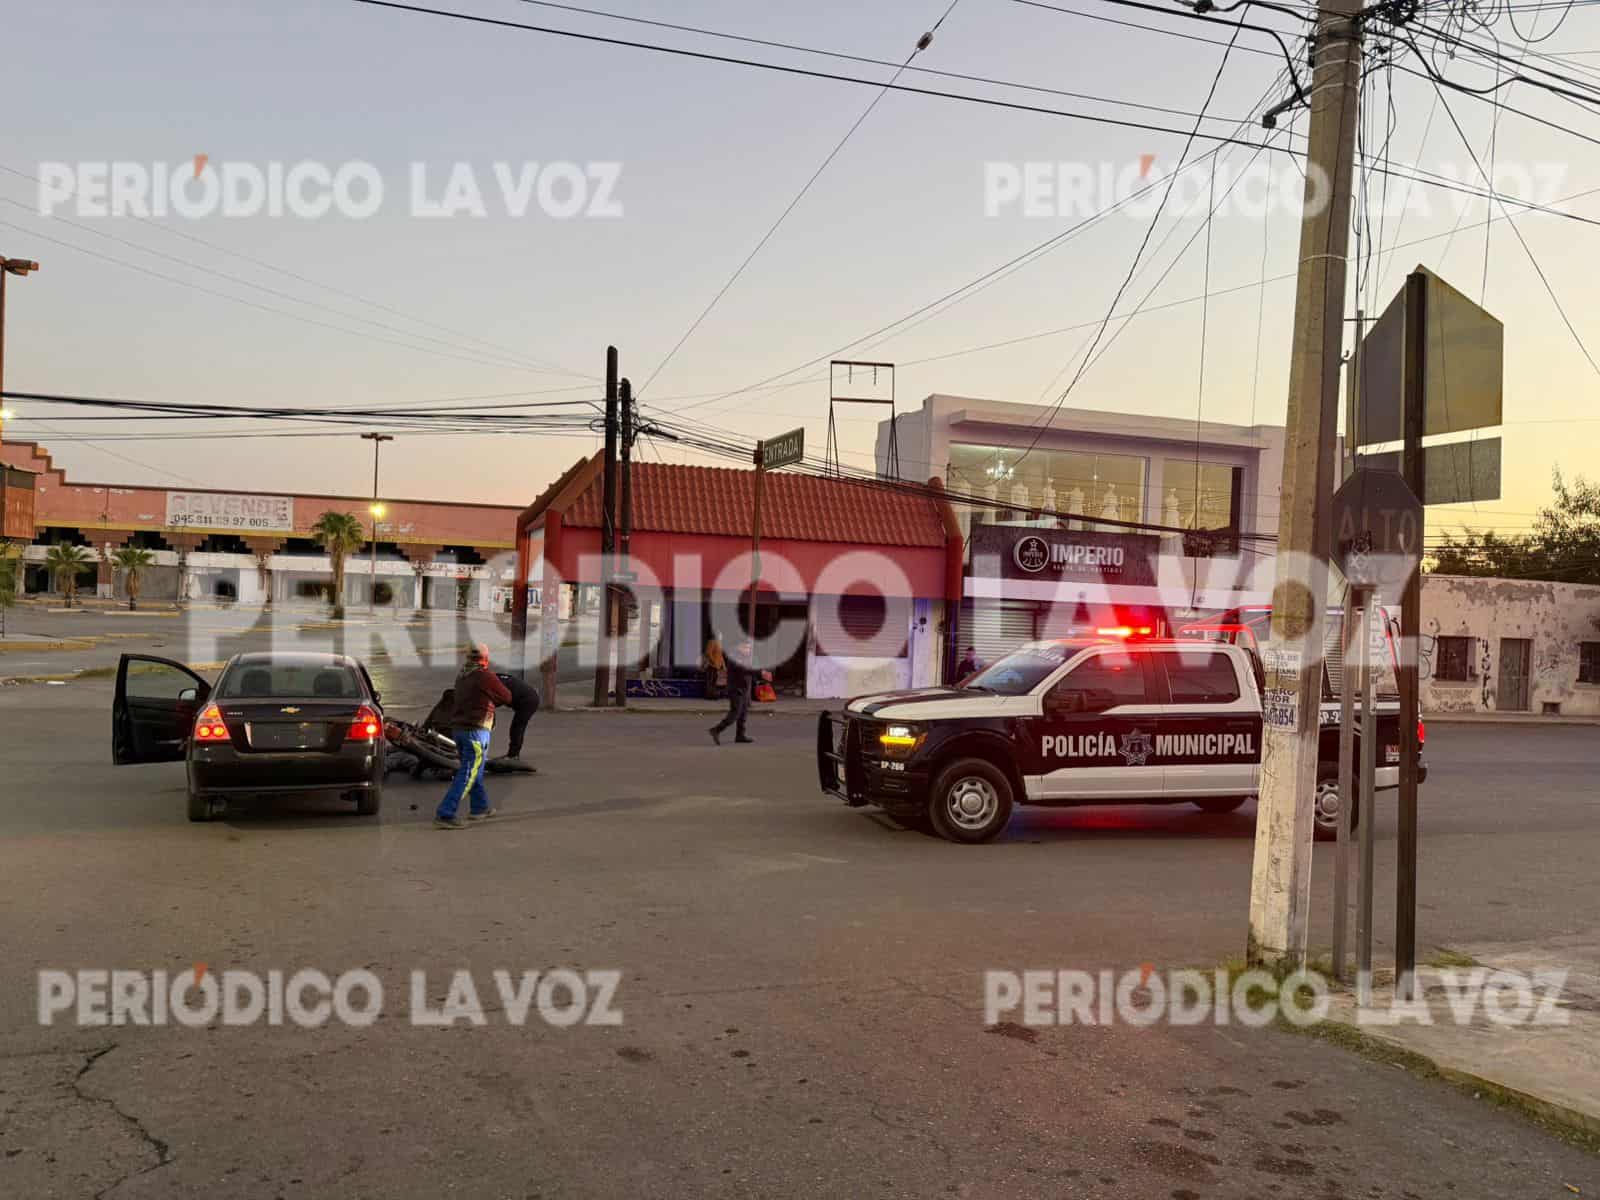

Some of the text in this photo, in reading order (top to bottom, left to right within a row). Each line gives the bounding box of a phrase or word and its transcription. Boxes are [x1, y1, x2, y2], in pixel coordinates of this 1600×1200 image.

[1339, 504, 1417, 554] ALTO
[1051, 543, 1124, 567] IMPERIO
[1042, 732, 1255, 757] POLICÍA MUNICIPAL
